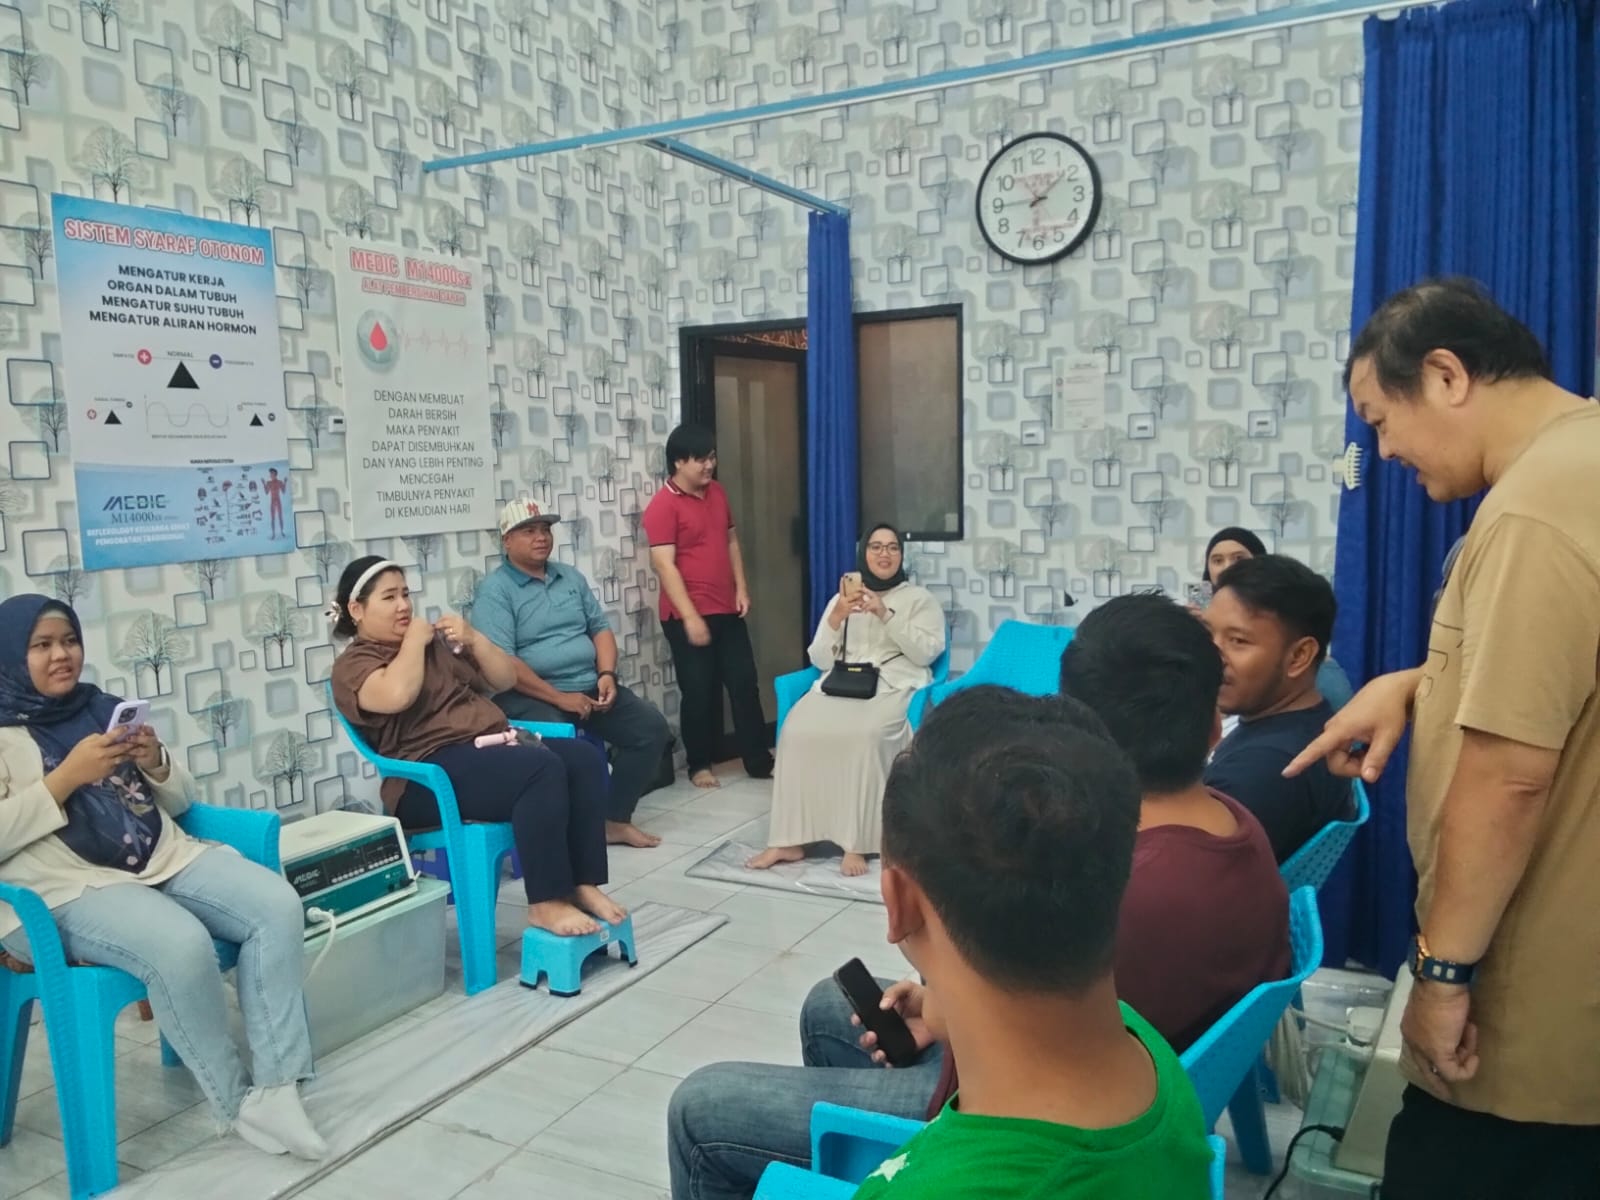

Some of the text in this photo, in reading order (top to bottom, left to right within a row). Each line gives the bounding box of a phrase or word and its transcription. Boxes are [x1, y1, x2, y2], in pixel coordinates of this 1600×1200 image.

[1011, 157, 1024, 174] 11
[1029, 148, 1046, 166] 12
[1066, 164, 1079, 182] 2
[997, 174, 1014, 192] 10
[1072, 185, 1085, 203] 3
[992, 197, 1004, 214] 9
[1066, 207, 1079, 224] 4
[998, 217, 1010, 234] 8
[64, 218, 265, 266] SISTEM SYARAF OTONOM
[1016, 230, 1027, 248] 7
[1032, 234, 1045, 251] 6
[1053, 226, 1065, 243] 5
[350, 248, 399, 277] MEDIC
[118, 265, 225, 288] MENGATUR KERJA
[107, 280, 237, 304] ORGAN DALAM TUBUH
[102, 295, 244, 320] MENGATUR SUHU TUBUH
[89, 311, 257, 336] MENGATUR ALIRAN HORMON
[374, 390, 464, 406] DENGAN MEMBUAT
[388, 408, 457, 421] DARAH BERSIH
[386, 425, 460, 436] MAKA PENYAKIT
[372, 440, 475, 452] DAPAT DISEMBUHKAN
[363, 457, 484, 469] DAN YANG LEBIH PENTING
[399, 474, 454, 485] MENCEGAH
[102, 494, 167, 511] MEDIC
[377, 488, 475, 502] TIMBULNYA PENYAKIT
[384, 503, 470, 519] DI KEMUDIAN HARI
